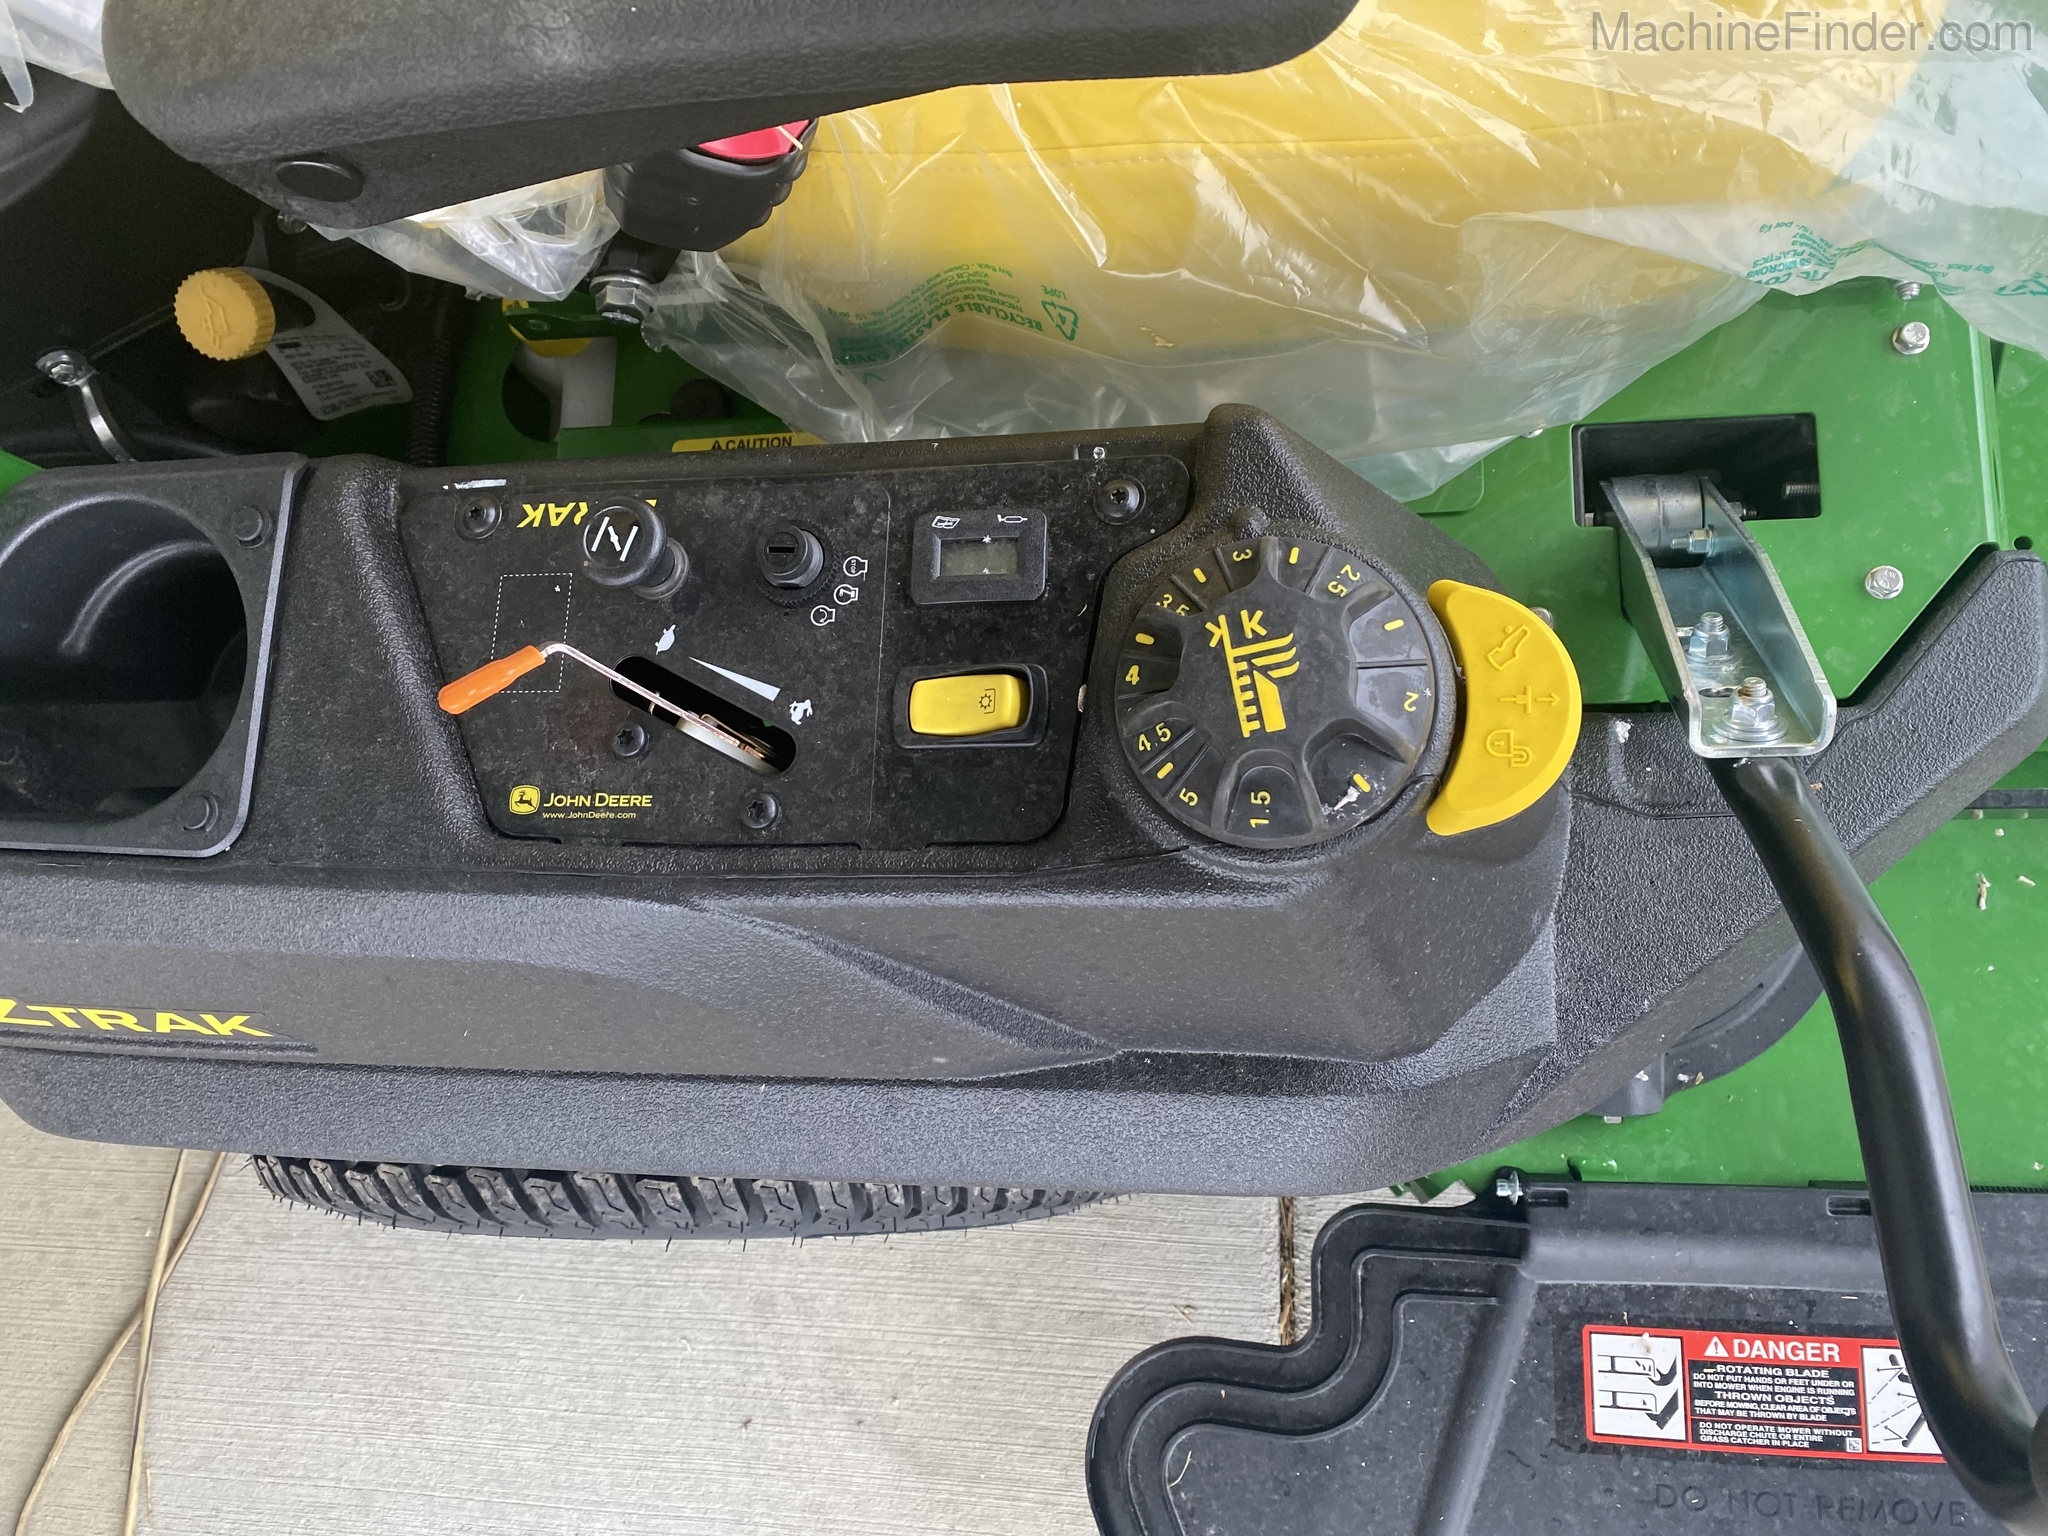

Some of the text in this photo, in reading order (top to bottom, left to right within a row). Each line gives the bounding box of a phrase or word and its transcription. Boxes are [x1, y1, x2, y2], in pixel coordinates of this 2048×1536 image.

[1774, 221, 1794, 229] per
[956, 270, 989, 279] KSPCB
[976, 263, 997, 273] Back
[998, 266, 1013, 278] Buy
[1745, 259, 1798, 279] MICRONS
[1973, 264, 1995, 275] Buy
[963, 293, 975, 301] OF
[1041, 284, 1067, 301] LDPE
[928, 296, 959, 315] COVER
[976, 293, 1024, 313] THICKNESS
[954, 302, 1044, 332] RECYCLABLE
[725, 436, 793, 450] CAUTION
[1232, 549, 1252, 562] 3
[1327, 564, 1361, 598] 2.5
[1125, 664, 1140, 685] 4
[1403, 691, 1420, 712] 2
[1138, 722, 1172, 751] 4.5
[595, 792, 653, 807] DEERE
[1179, 787, 1199, 807] 5
[542, 811, 637, 819] www.JohnDeere.com
[1249, 790, 1271, 829] 1.5
[1733, 1338, 1841, 1363] DANGER
[1716, 1364, 1830, 1378] ROTATING BLADE
[1715, 1382, 1746, 1390] MOWER
[1748, 1384, 1773, 1392] WHEN
[1775, 1385, 1806, 1393] ENGINE
[1817, 1388, 1856, 1396] RUNNING
[1788, 1378, 1810, 1386] FEET
[1811, 1379, 1840, 1387] UNDER
[1842, 1380, 1855, 1388] OR
[1714, 1391, 1835, 1405] THROWN OBJECTS
[1694, 1399, 1726, 1408] BEFORE
[1727, 1401, 1760, 1410] MOWING,
[1761, 1403, 1787, 1411] CLEAR
[1788, 1404, 1809, 1412] AREA
[1821, 1406, 1857, 1415] OBJECTS
[1695, 1407, 1716, 1415] THAT
[1718, 1408, 1735, 1416] MAY
[1749, 1410, 1785, 1419] THROWN
[1786, 1412, 1799, 1420] BY
[1799, 1414, 1828, 1422] BLADE
[1699, 1421, 1854, 1437] DO NOT OPERATE MOWER WITHOUT
[1700, 1428, 1748, 1438] DISCHARGE
[1749, 1431, 1778, 1440] CHUTE
[1793, 1434, 1824, 1442] ENTIRE
[1700, 1435, 1810, 1448] GRASS CATCHER IN PLACE
[1656, 1483, 1966, 1528] DO NOT REMOVE
